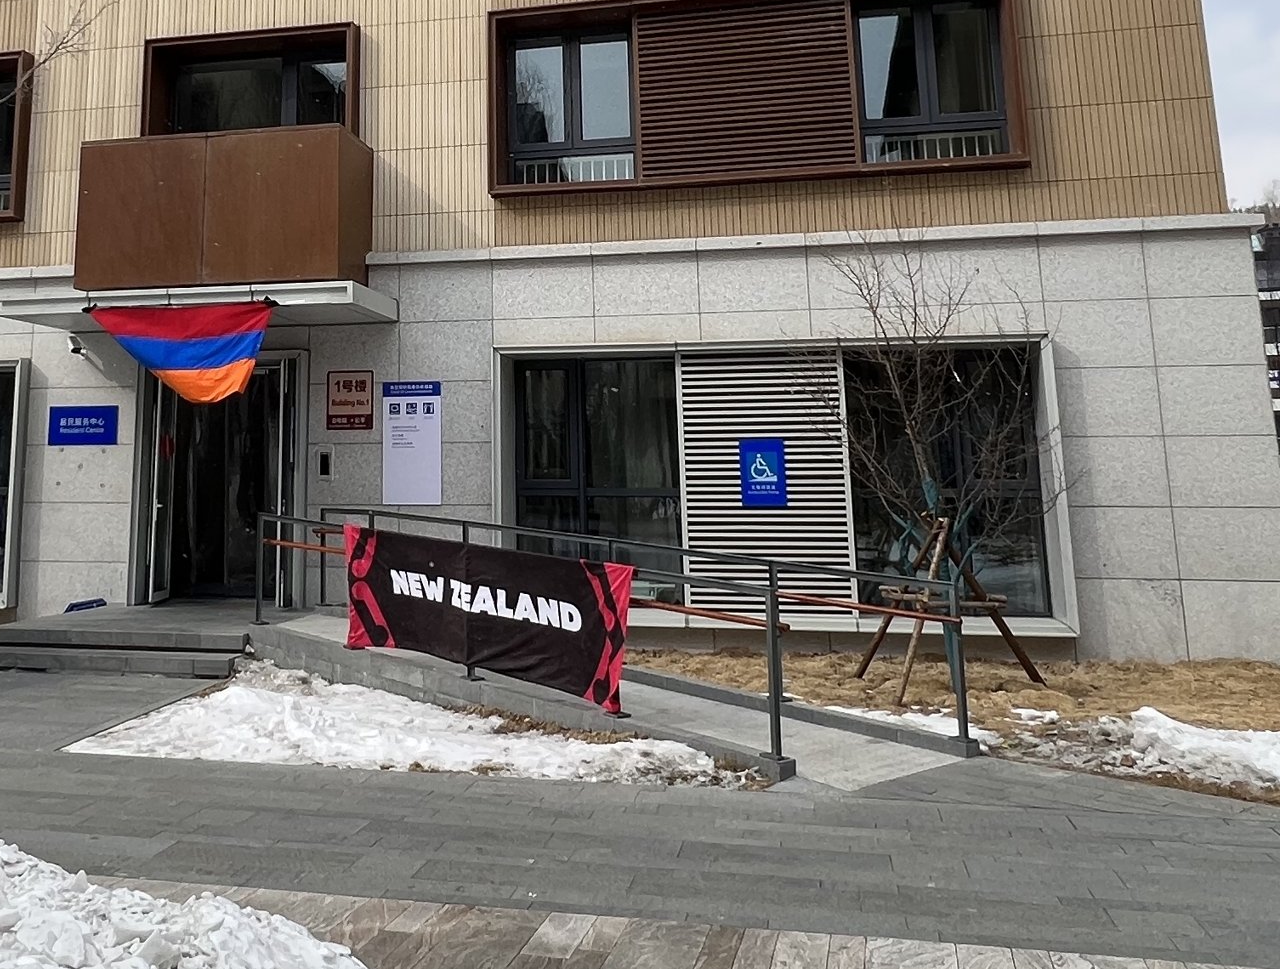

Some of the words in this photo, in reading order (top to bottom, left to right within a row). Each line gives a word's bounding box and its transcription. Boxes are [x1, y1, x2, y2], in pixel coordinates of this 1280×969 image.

[334, 379, 367, 393] 1号楼
[390, 569, 444, 603] NEW
[449, 579, 582, 632] ZEALAND
